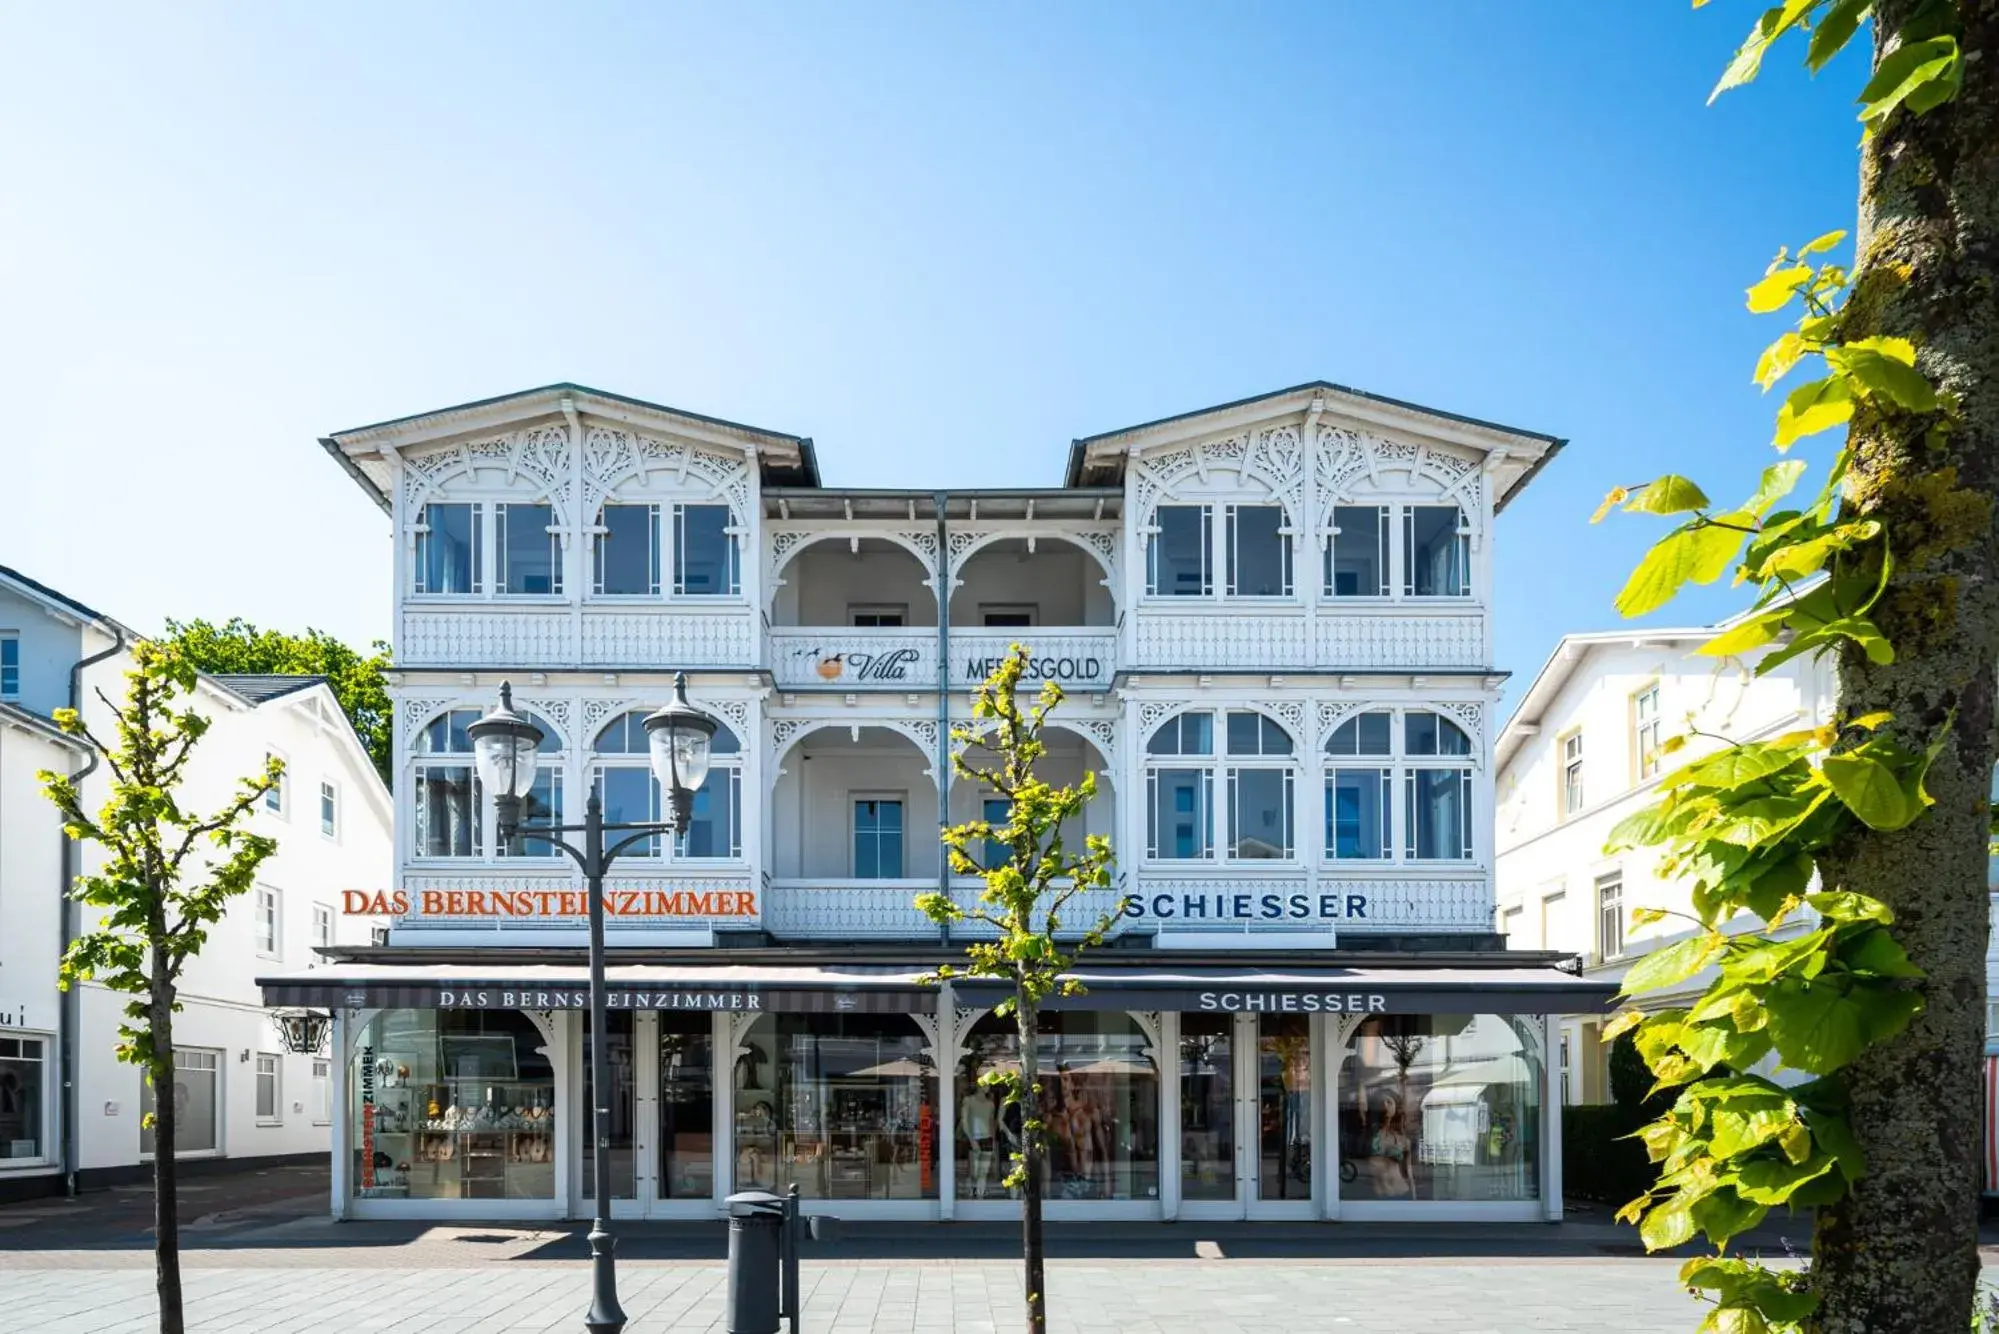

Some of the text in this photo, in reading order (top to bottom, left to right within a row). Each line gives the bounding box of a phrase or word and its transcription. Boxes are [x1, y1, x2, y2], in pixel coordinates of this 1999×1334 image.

[848, 649, 1100, 680] Villa MESGOLD
[342, 889, 409, 916] DAS
[1123, 894, 1368, 919] SCHIESSER
[439, 991, 761, 1009] DAS BERNSEINZIMMER
[1200, 992, 1386, 1012] SCHIESSER
